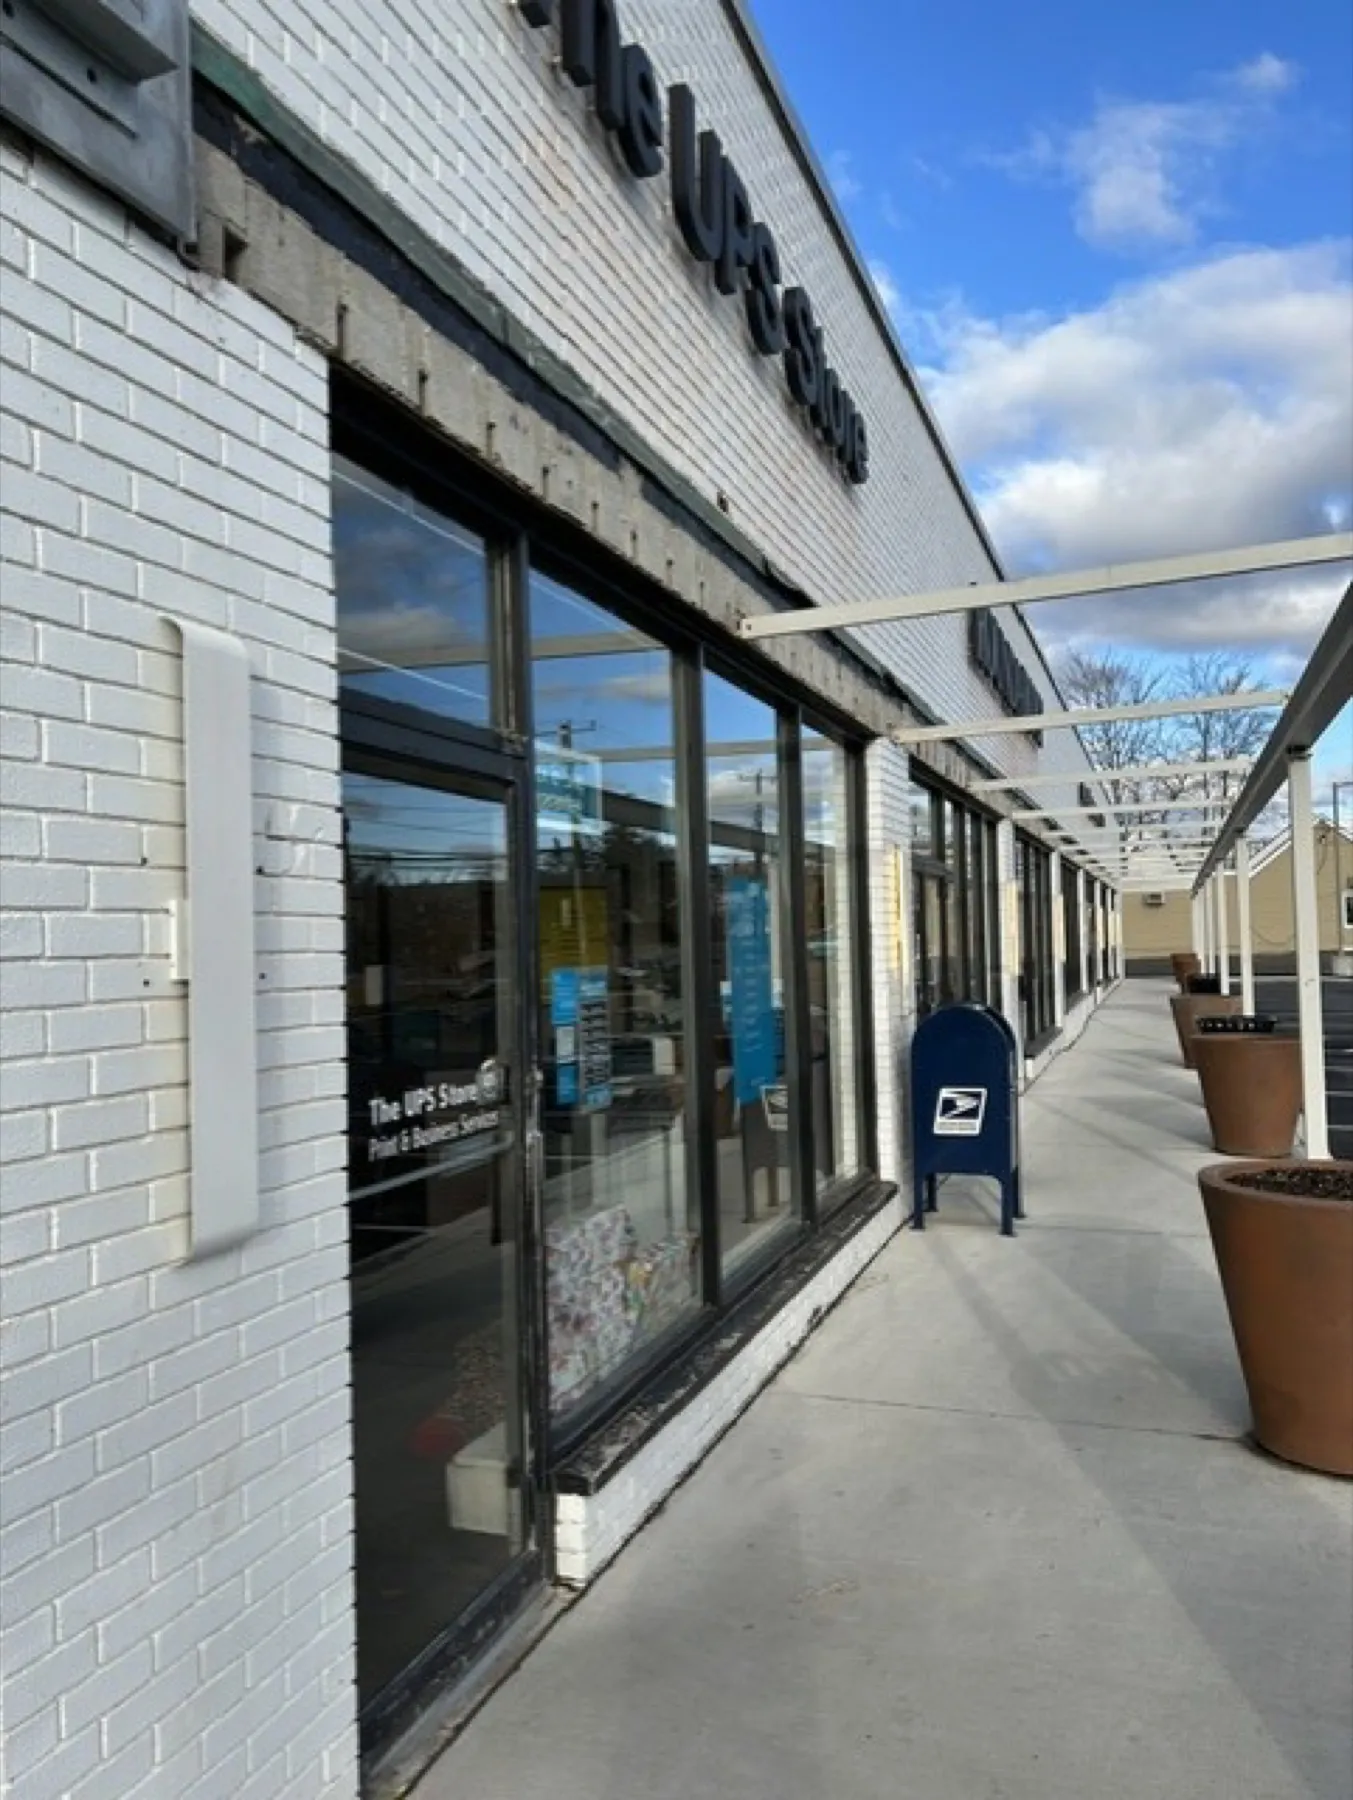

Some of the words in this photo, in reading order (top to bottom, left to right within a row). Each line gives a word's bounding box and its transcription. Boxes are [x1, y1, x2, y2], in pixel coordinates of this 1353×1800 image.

[668, 83, 786, 356] UPS
[783, 287, 869, 484] Store
[369, 1097, 400, 1125] The
[404, 1086, 436, 1116] UPS
[438, 1083, 478, 1109] Store
